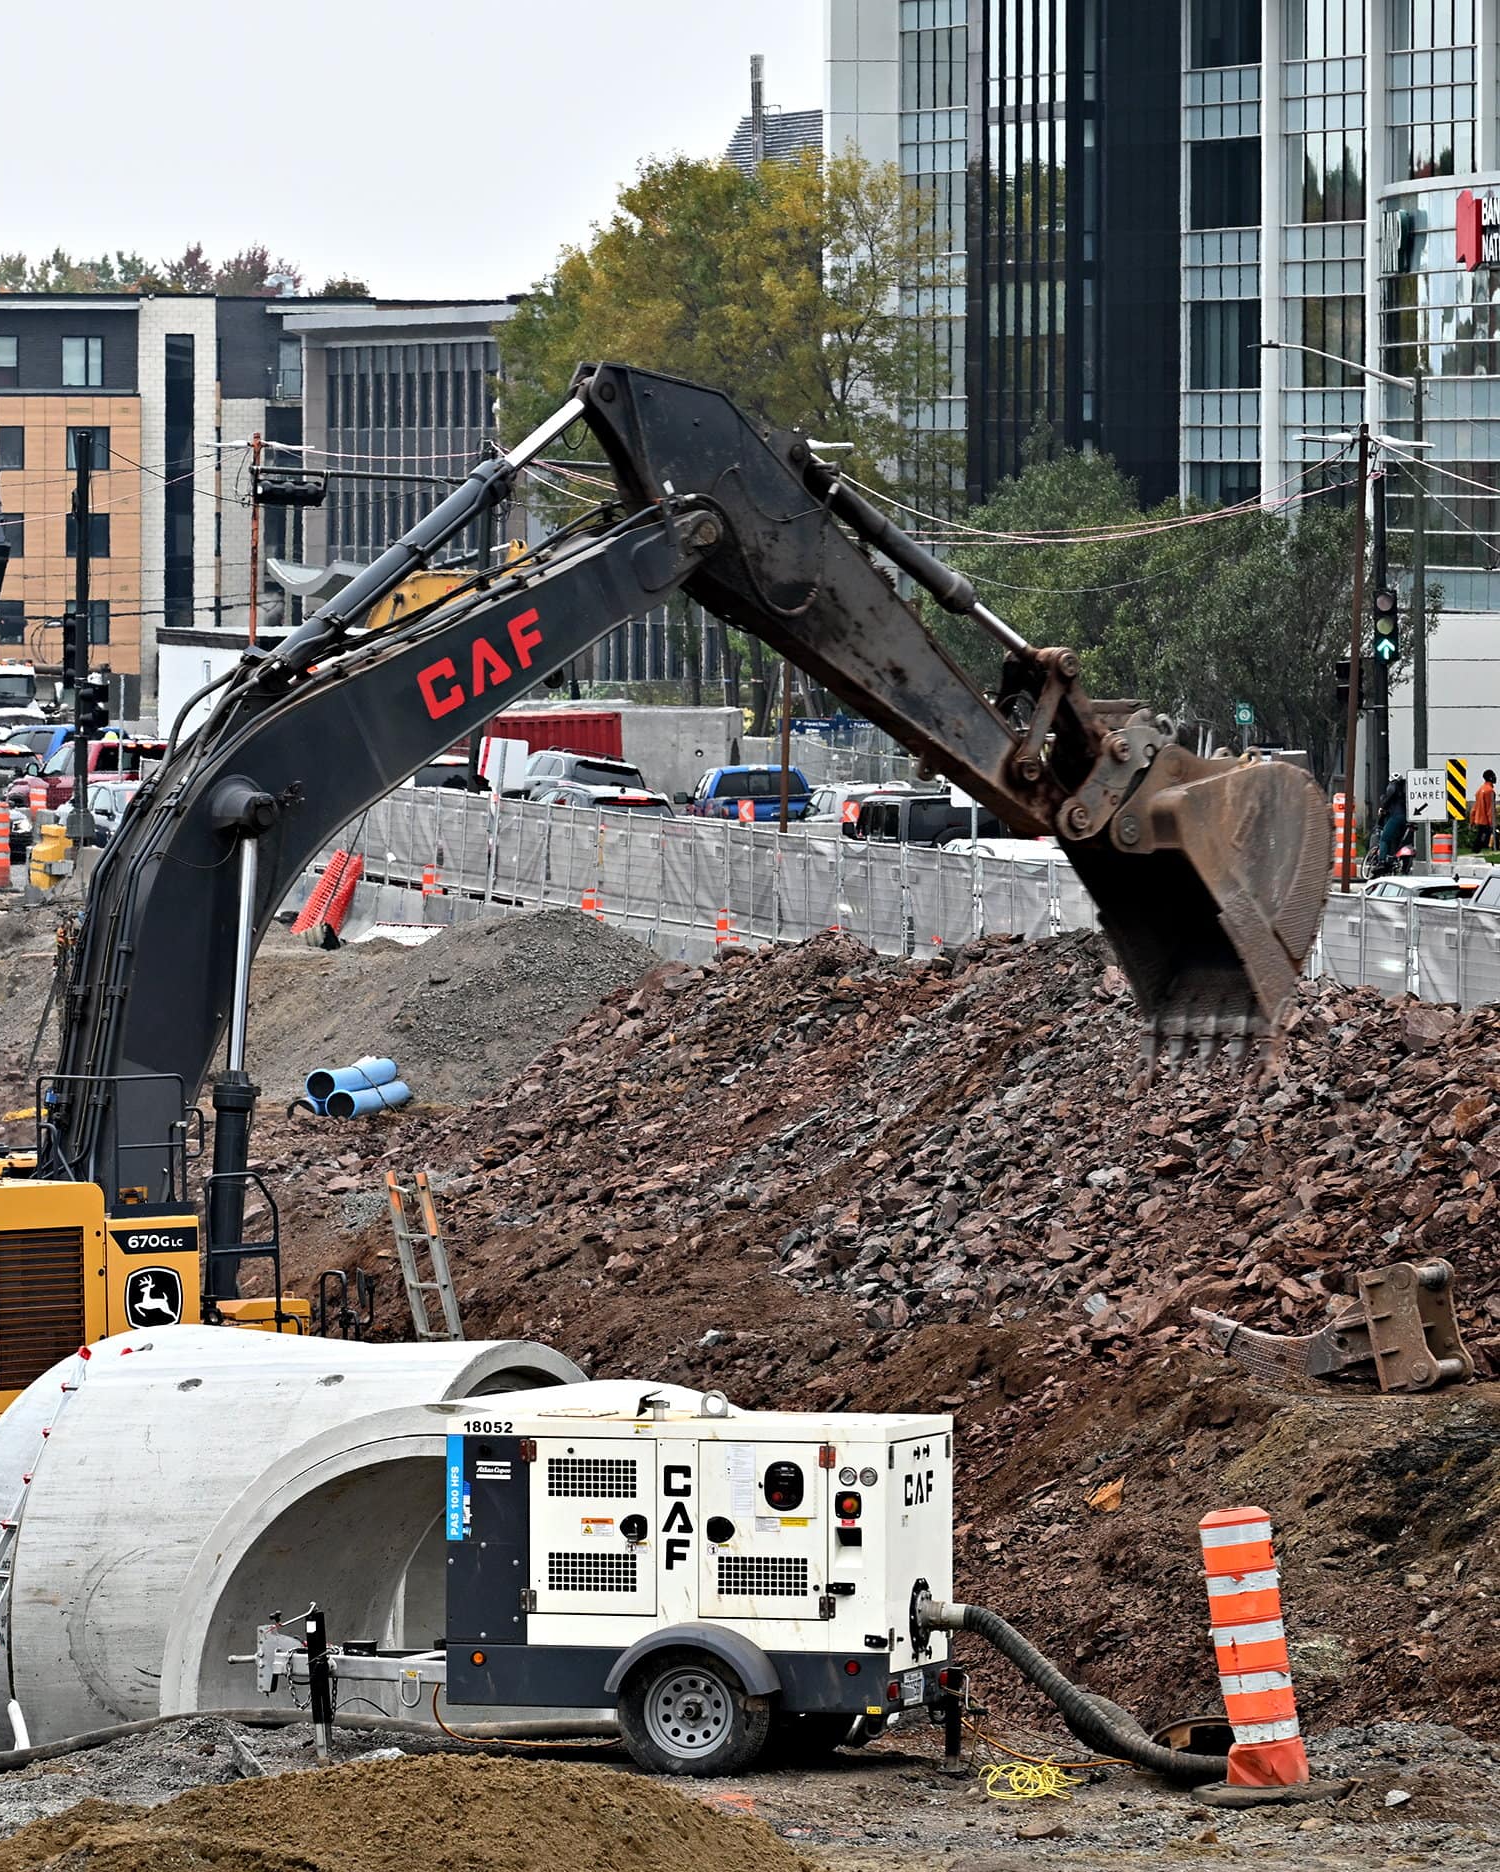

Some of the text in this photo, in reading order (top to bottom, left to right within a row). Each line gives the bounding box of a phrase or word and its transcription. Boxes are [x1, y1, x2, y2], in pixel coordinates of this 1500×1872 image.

[416, 607, 542, 720] CAF
[1414, 776, 1440, 785] LIGNE
[1410, 789, 1445, 800] D'ARRÊT
[128, 1234, 183, 1248] 670G LC
[464, 1420, 513, 1433] 18052
[450, 1466, 459, 1536] PAS 100 HFS
[904, 1470, 934, 1507] CAF
[662, 1465, 694, 1570] CAF
